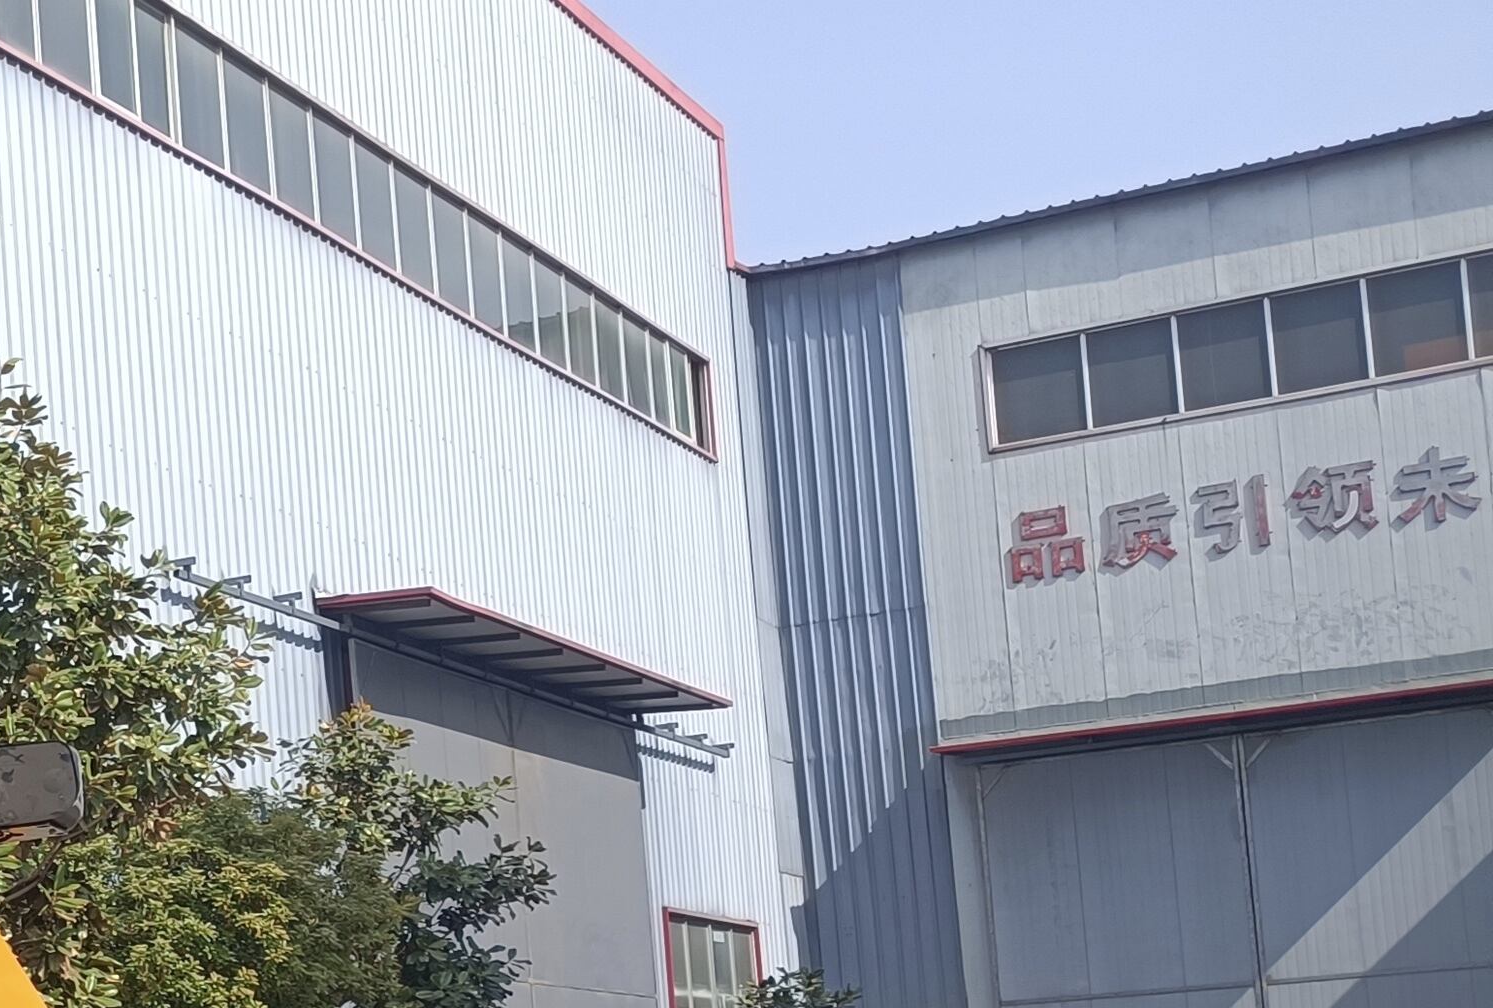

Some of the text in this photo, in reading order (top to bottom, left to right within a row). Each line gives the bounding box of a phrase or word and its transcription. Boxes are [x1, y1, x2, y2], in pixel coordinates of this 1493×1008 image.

[1011, 445, 1482, 583] 品质引领未
